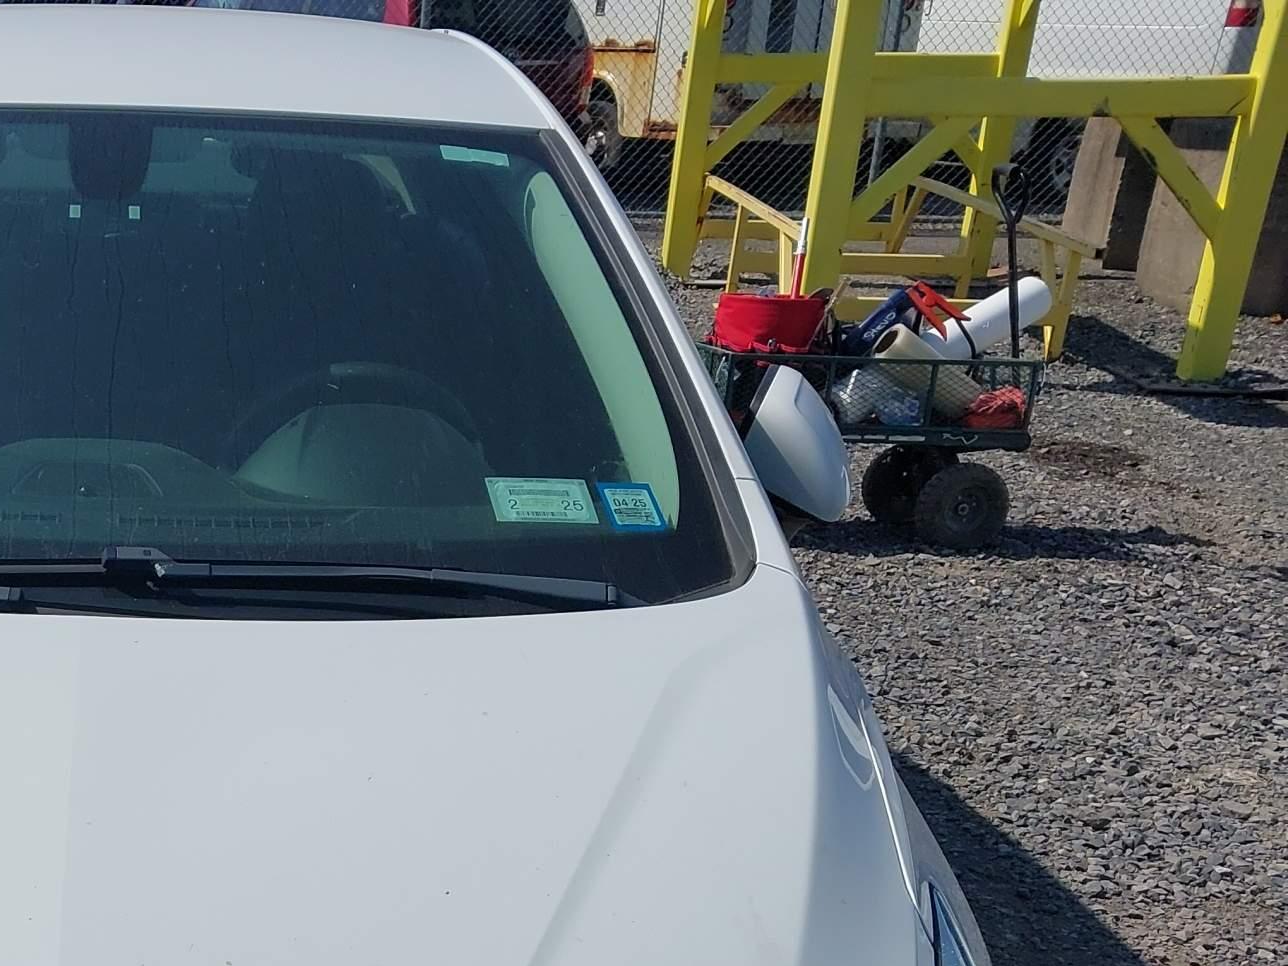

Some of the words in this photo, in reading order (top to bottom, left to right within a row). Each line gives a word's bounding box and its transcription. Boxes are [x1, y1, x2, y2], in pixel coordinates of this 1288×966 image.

[507, 498, 520, 511] 2
[561, 499, 584, 512] 25
[612, 498, 629, 507] 04
[631, 498, 647, 508] 25
